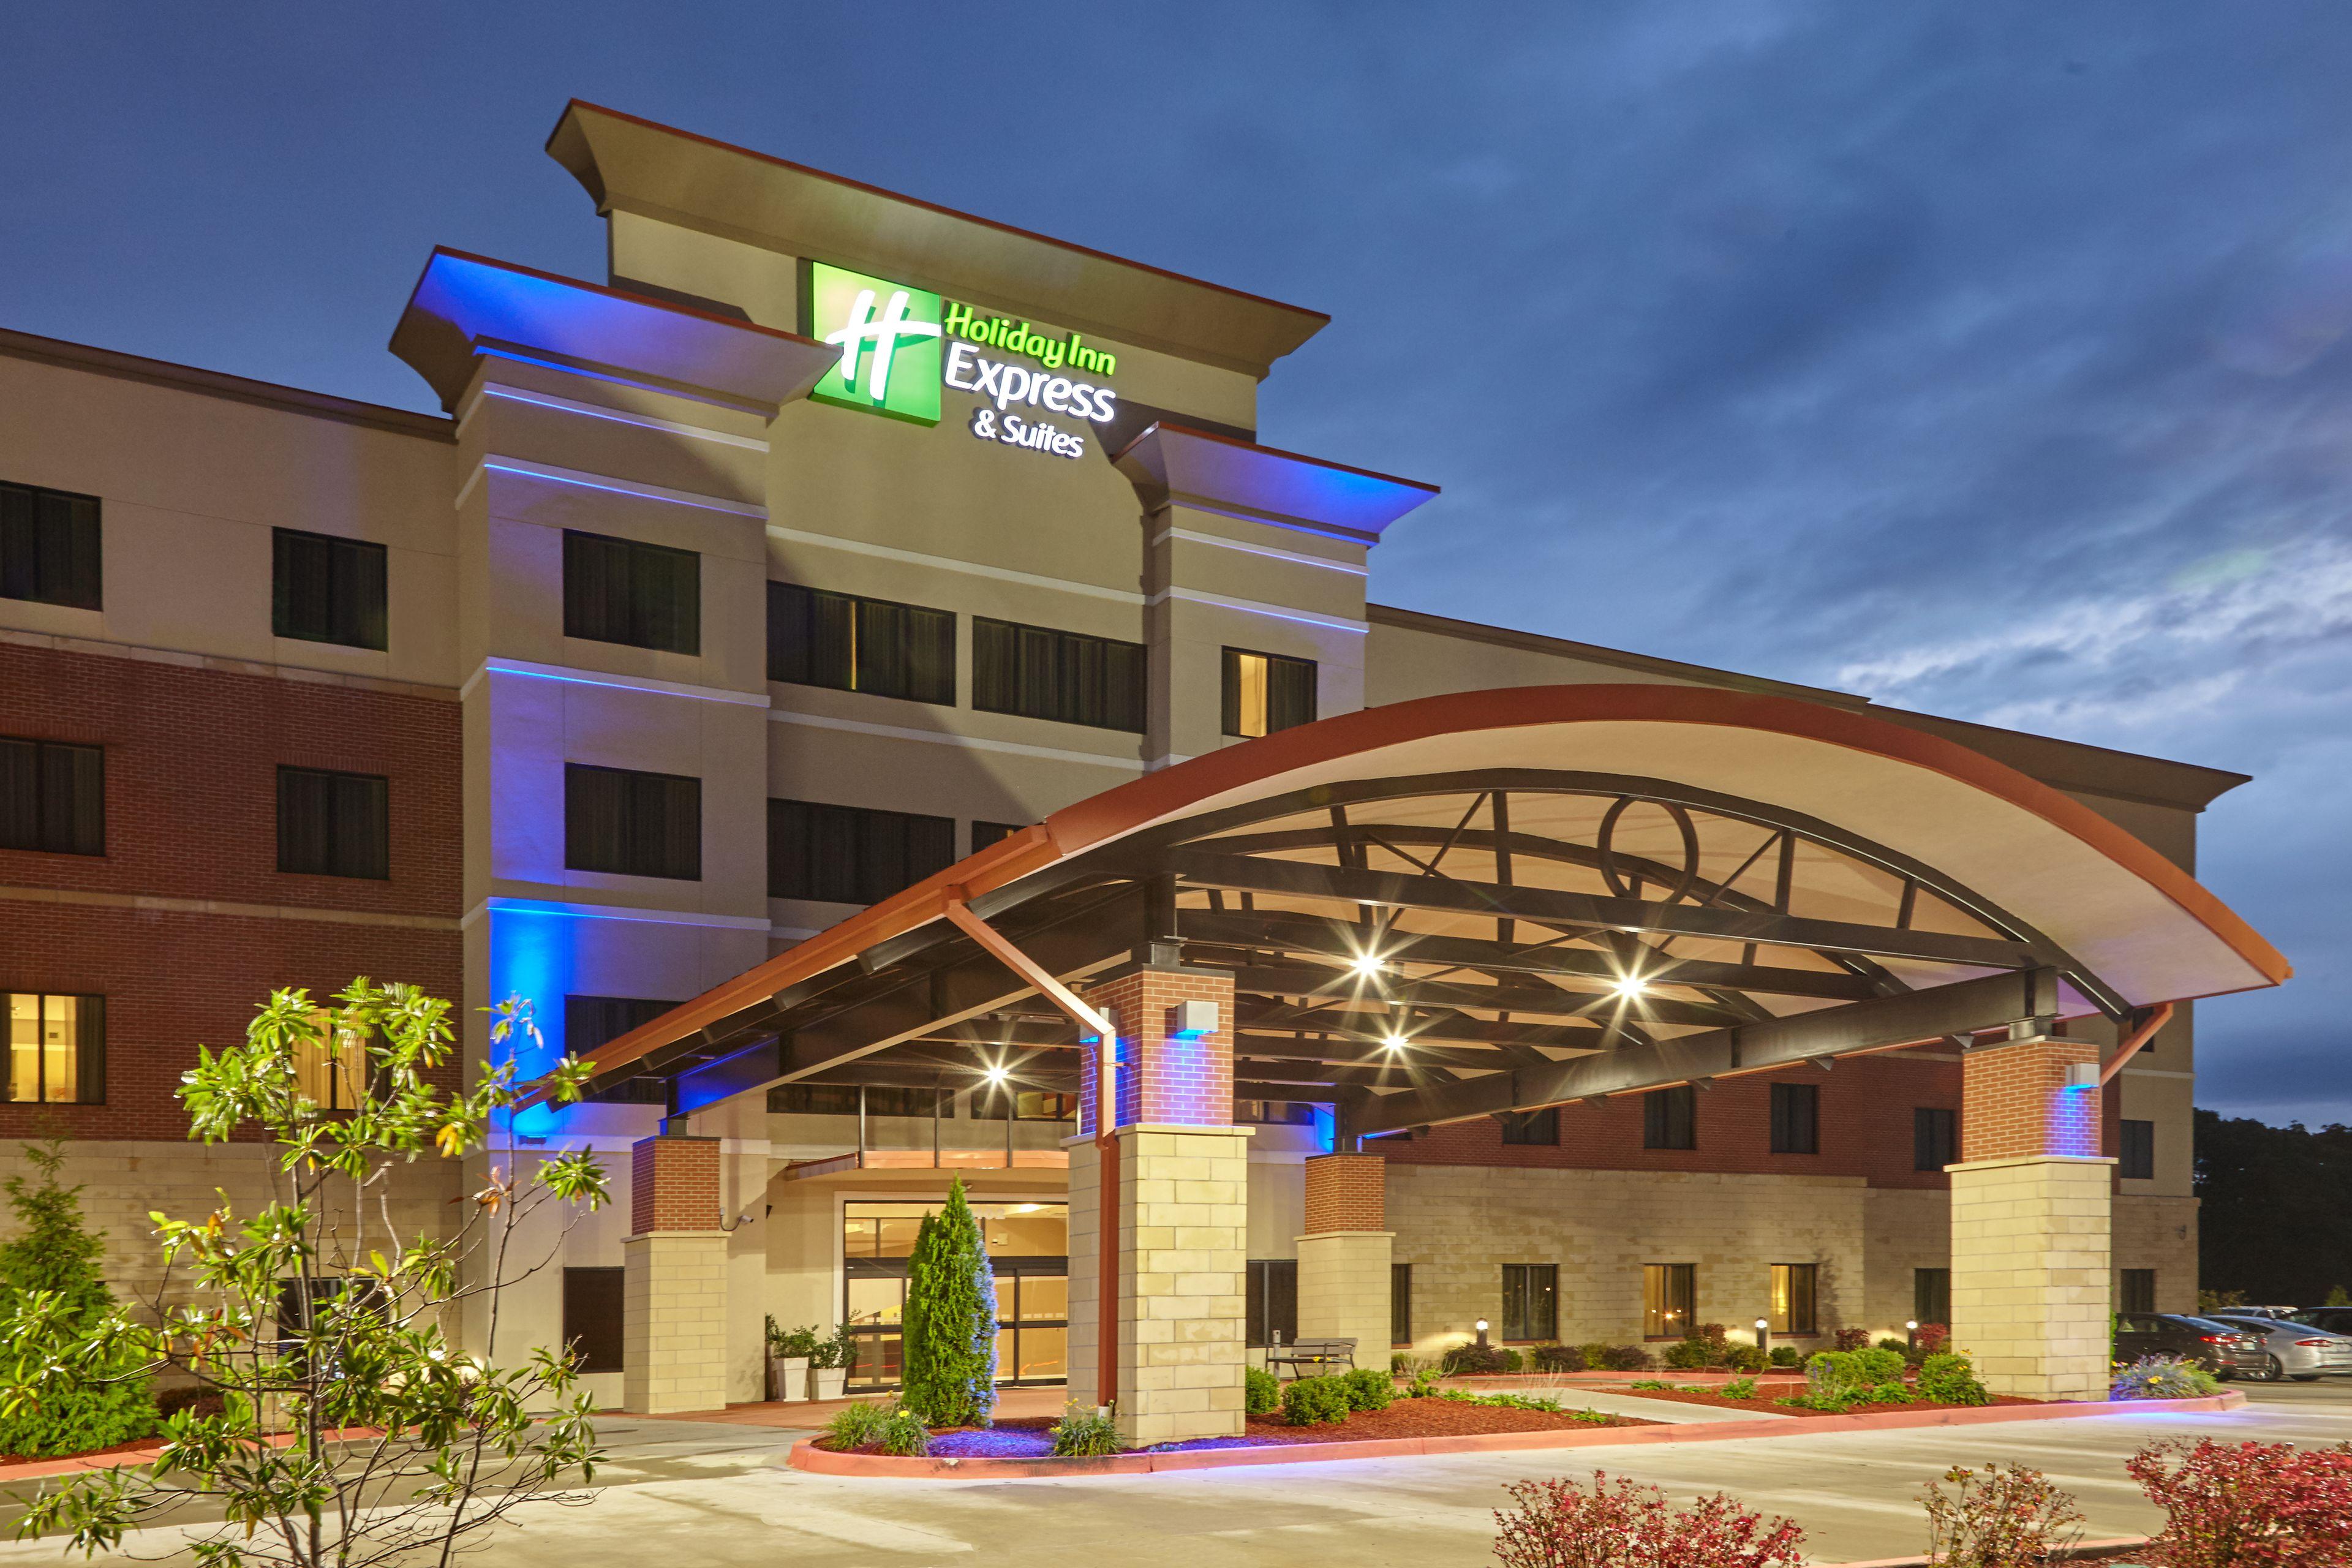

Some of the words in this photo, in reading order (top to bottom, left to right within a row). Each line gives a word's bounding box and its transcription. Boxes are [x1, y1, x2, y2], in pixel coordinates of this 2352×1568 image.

[944, 303, 1065, 368] Holiday
[1069, 334, 1117, 375] Inn
[945, 341, 1117, 423] Express
[974, 410, 997, 439] &
[1001, 415, 1084, 458] Suites
